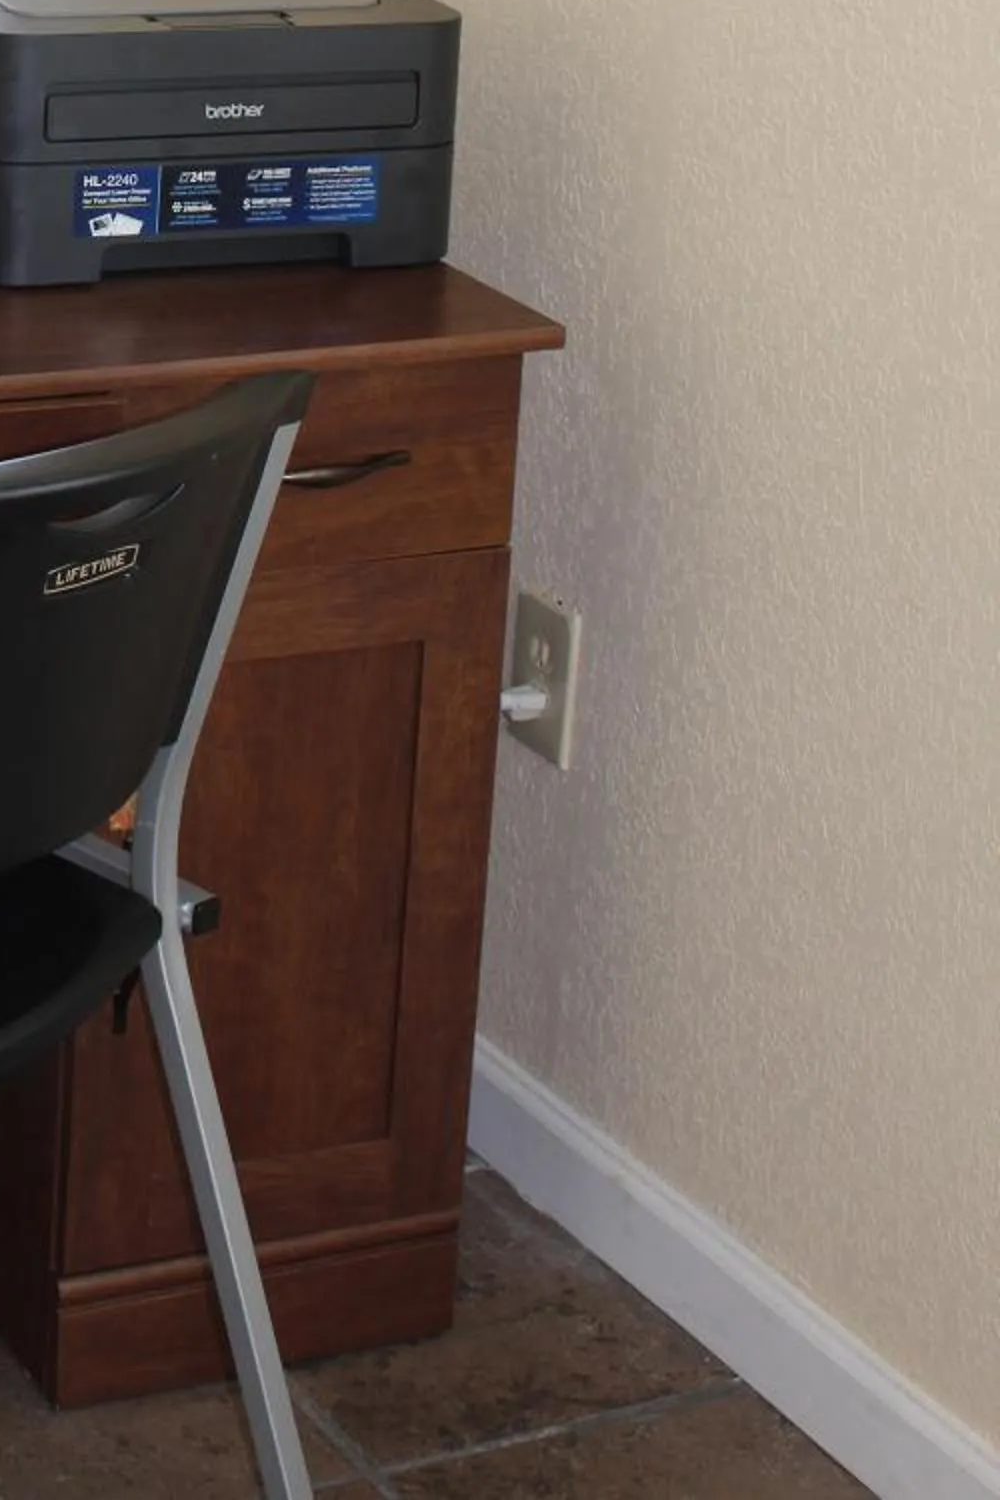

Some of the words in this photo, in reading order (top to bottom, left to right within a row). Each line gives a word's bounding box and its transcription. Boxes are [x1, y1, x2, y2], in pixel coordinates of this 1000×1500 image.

[205, 103, 265, 119] brother
[83, 173, 139, 188] HL-2240
[55, 551, 127, 586] LIFETIME
